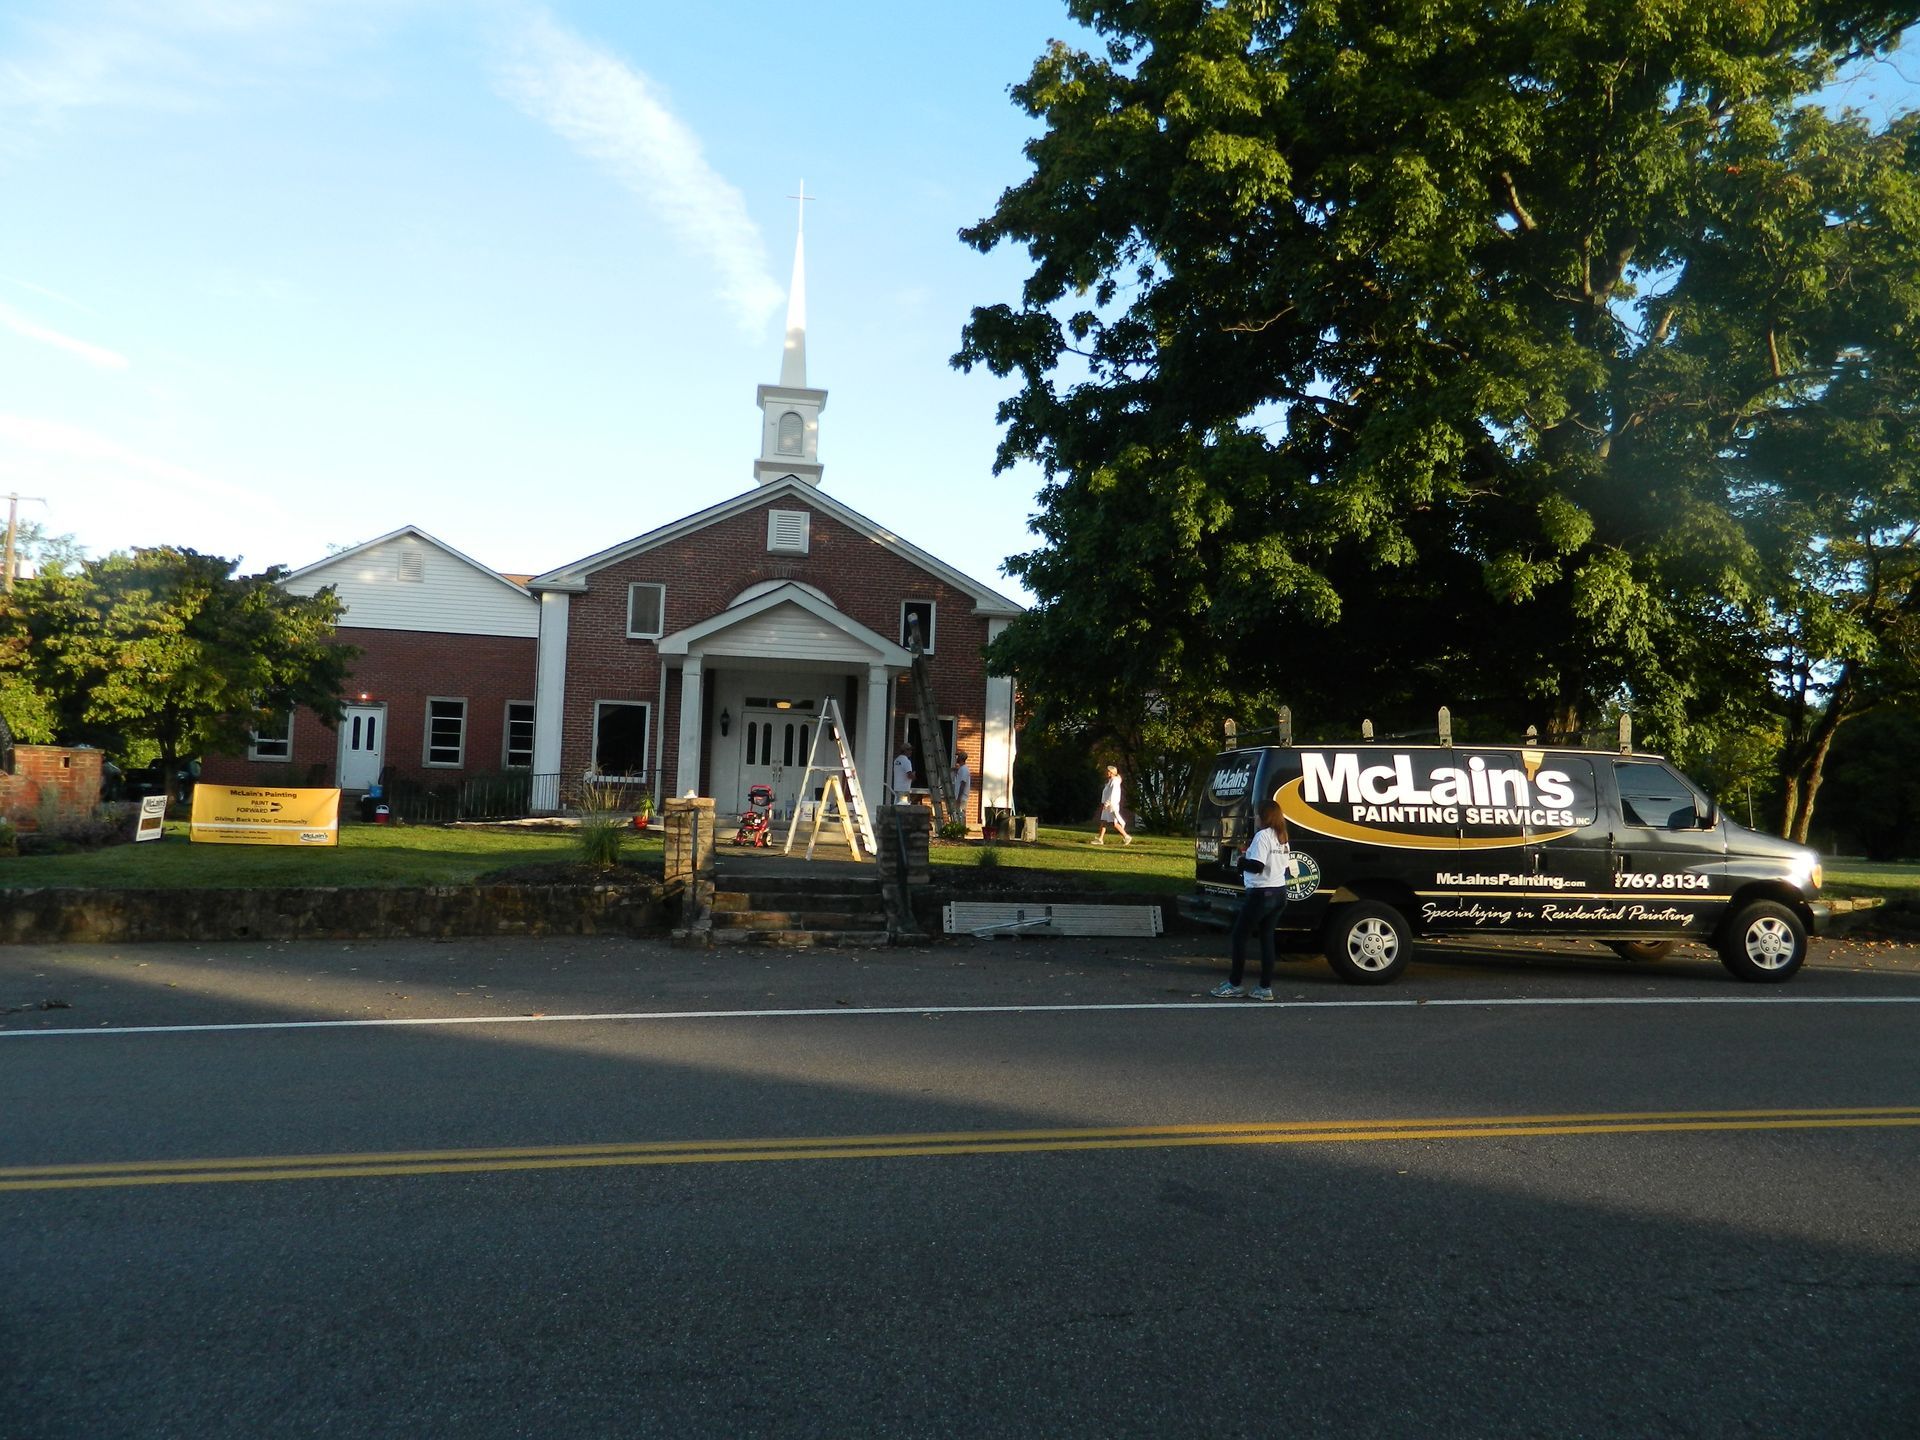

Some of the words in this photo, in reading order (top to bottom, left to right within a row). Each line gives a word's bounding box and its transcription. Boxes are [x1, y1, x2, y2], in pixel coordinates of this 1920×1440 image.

[1212, 763, 1250, 790] McLain's
[1300, 751, 1575, 810] McLain's
[230, 789, 263, 797] McLain's
[265, 791, 297, 799] Painting
[1352, 805, 1459, 825] PAINTING
[1465, 807, 1575, 827] SERVICES
[302, 831, 329, 840] McLain's
[1296, 853, 1318, 873] MOORE
[1286, 891, 1305, 899] GIE'S
[1304, 882, 1316, 896] LIST
[1436, 872, 1586, 890] McLainsPainting.com
[1621, 873, 1710, 889] 769.8134
[1421, 902, 1512, 926] Specializing
[1515, 906, 1535, 918] in
[1541, 904, 1626, 922] Residential
[1628, 905, 1695, 927] Painting
